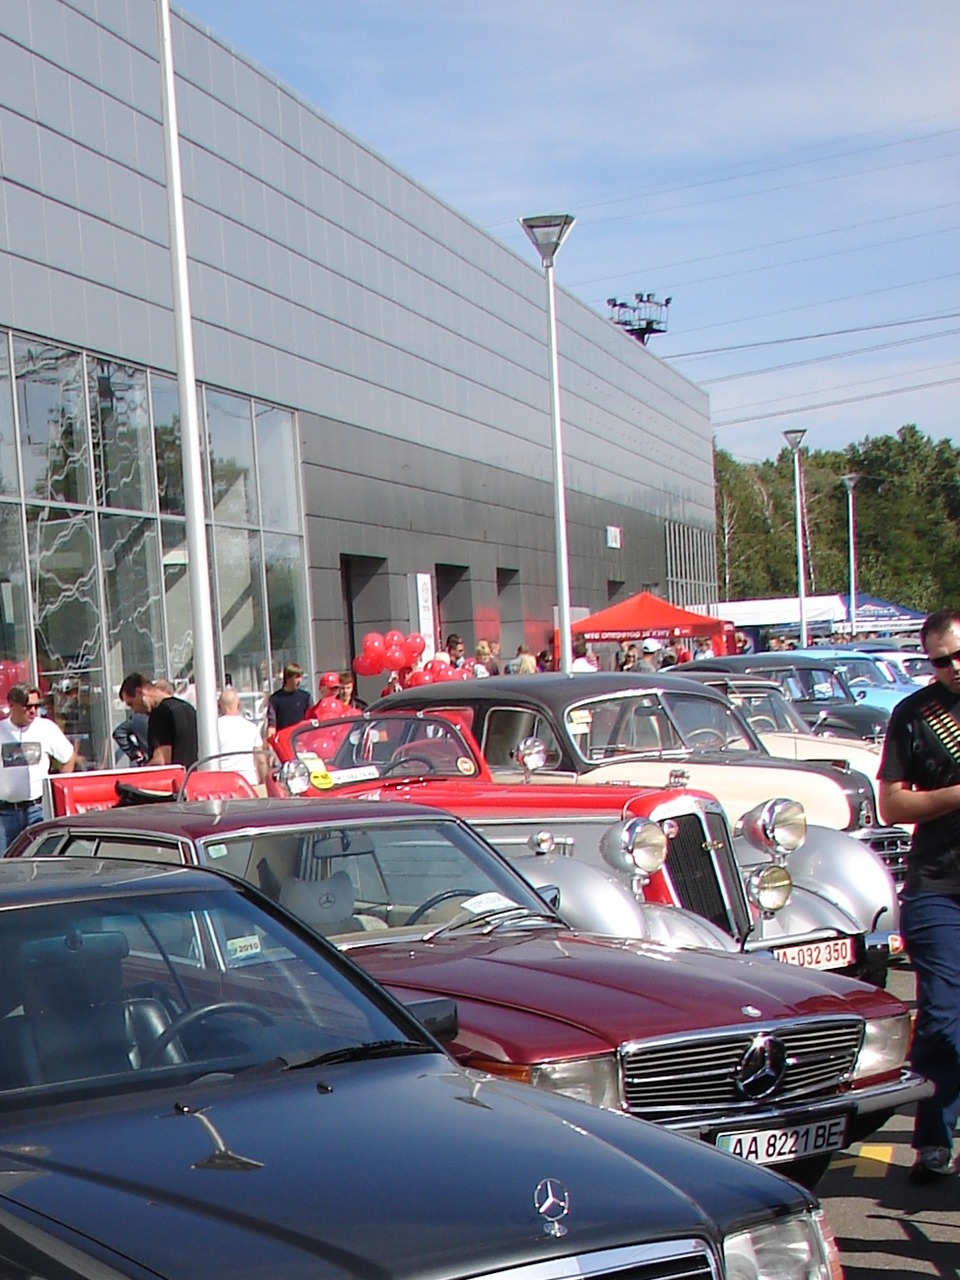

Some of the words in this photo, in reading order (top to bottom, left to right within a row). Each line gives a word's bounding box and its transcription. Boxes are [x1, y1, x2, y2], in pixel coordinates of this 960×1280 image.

[238, 942, 259, 953] 2010
[824, 941, 848, 962] 350
[732, 1136, 758, 1160] AA
[765, 1128, 810, 1158] 8221
[813, 1121, 841, 1150] BE
